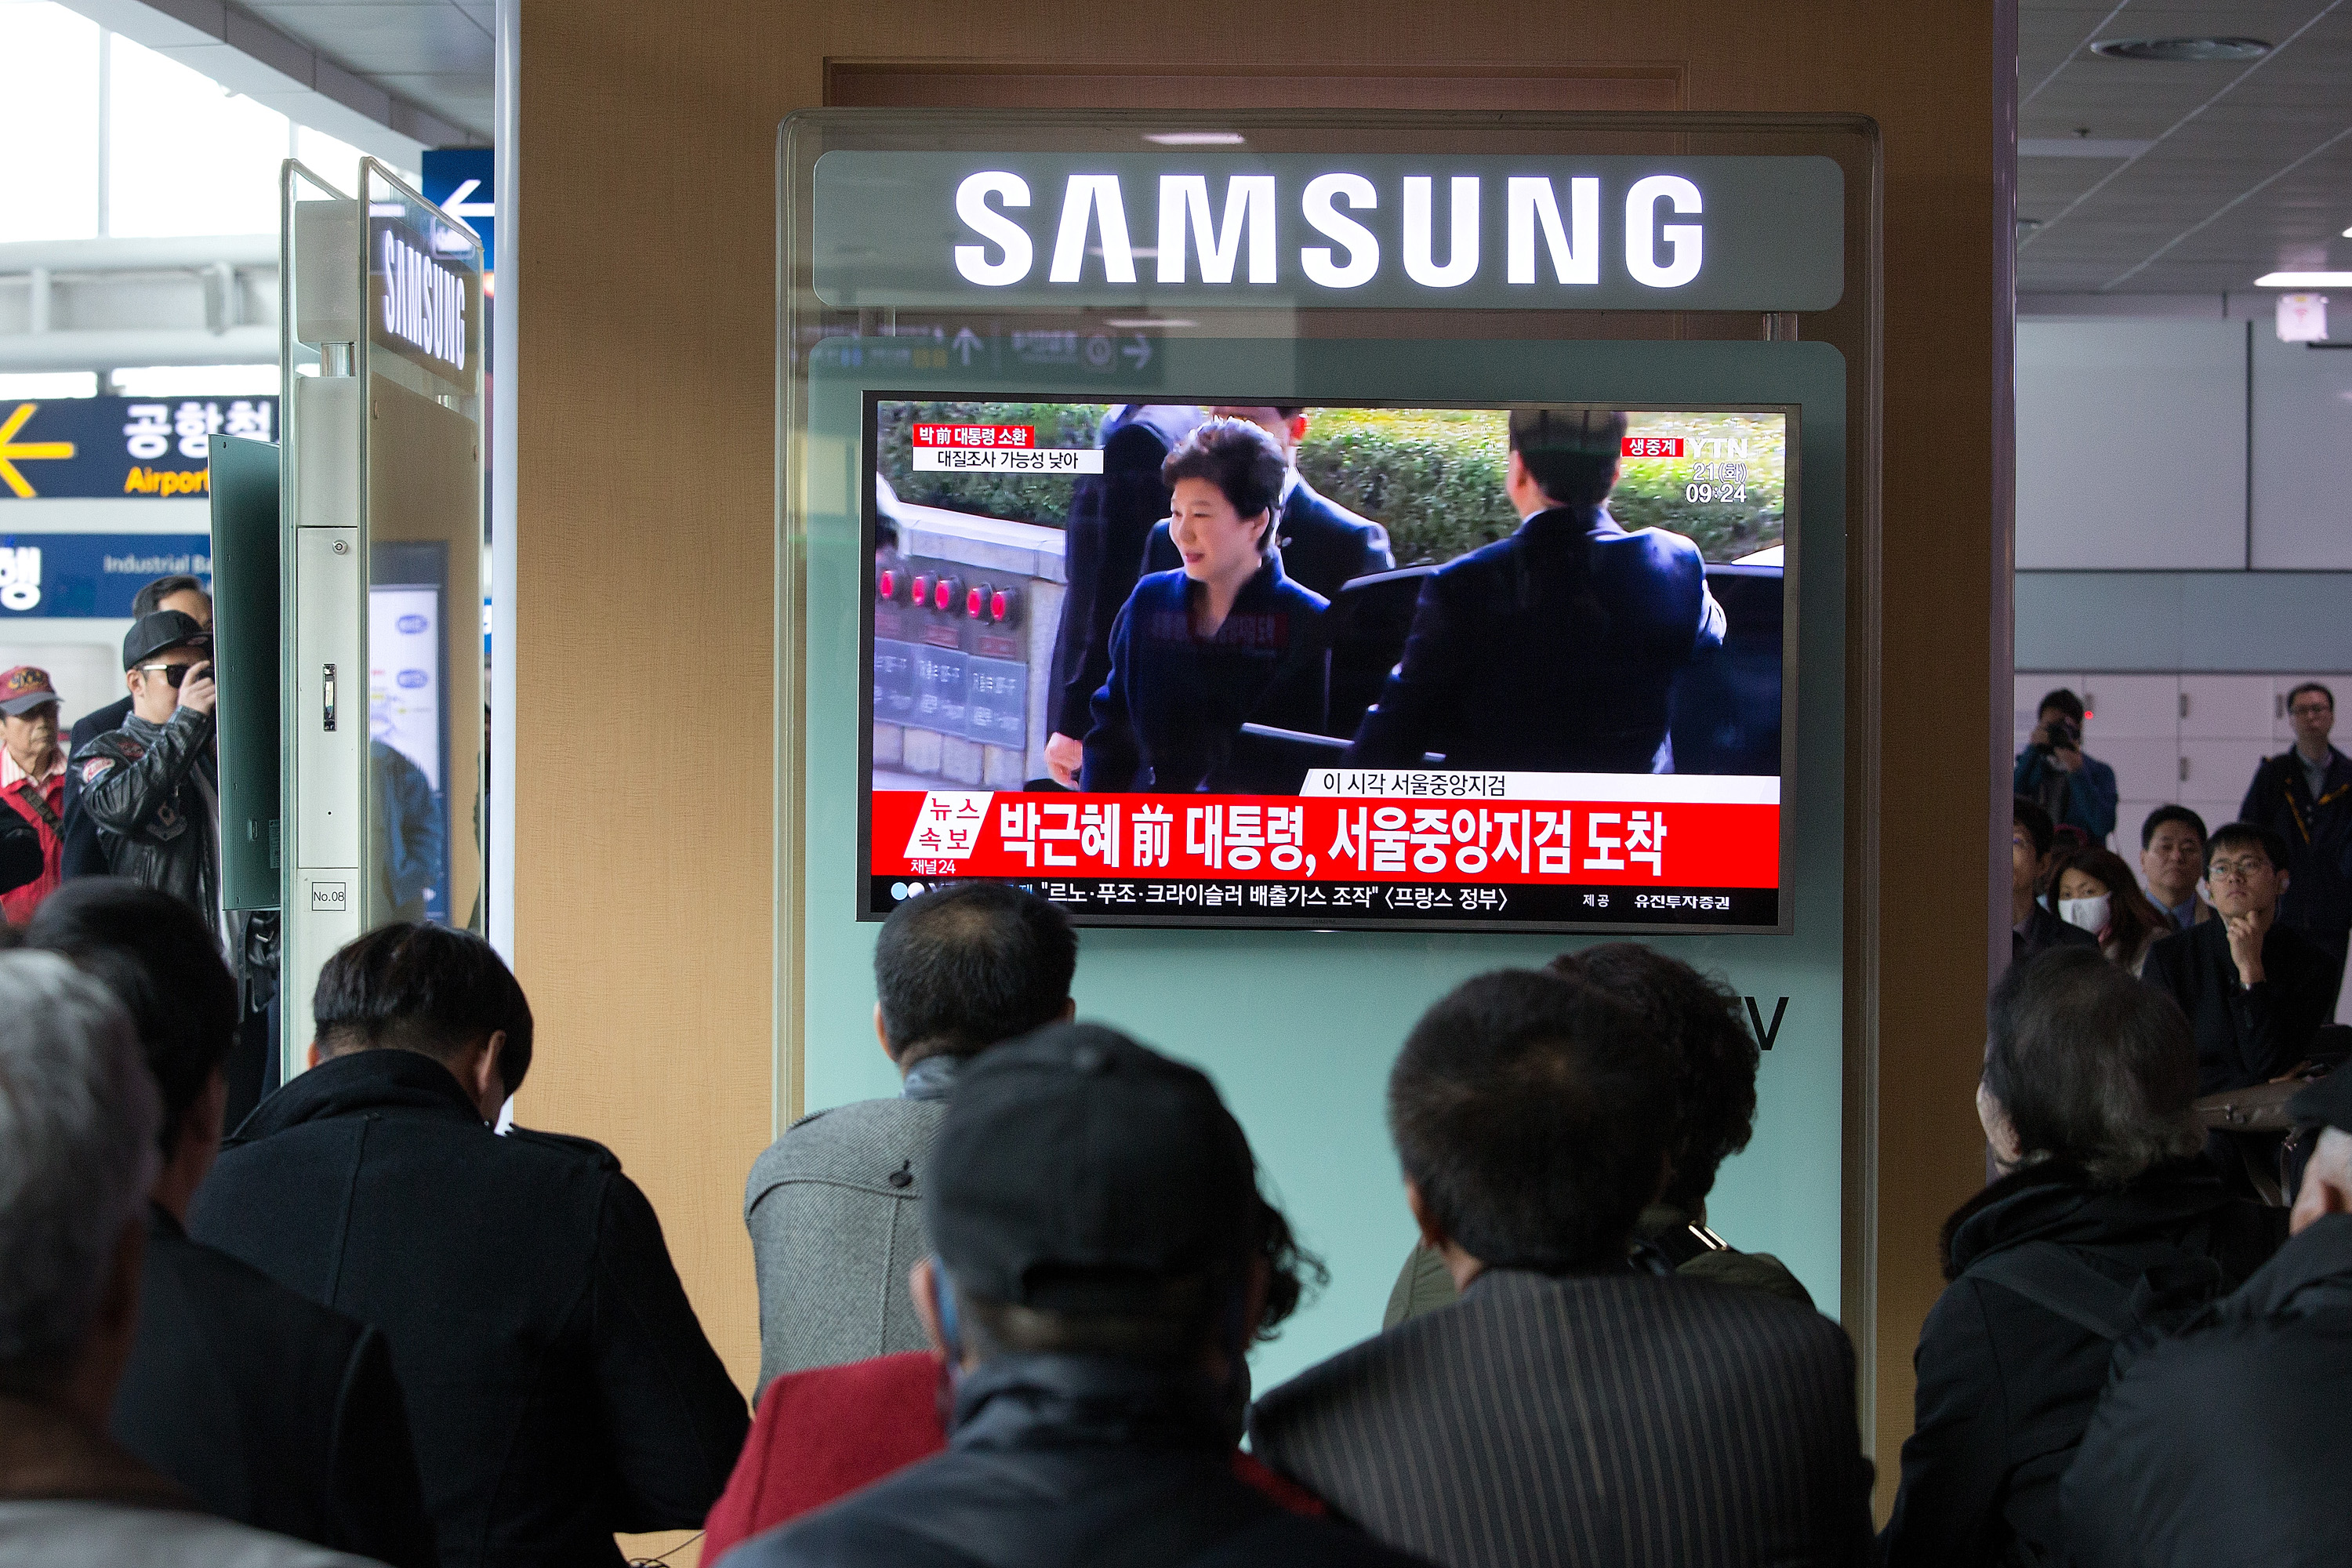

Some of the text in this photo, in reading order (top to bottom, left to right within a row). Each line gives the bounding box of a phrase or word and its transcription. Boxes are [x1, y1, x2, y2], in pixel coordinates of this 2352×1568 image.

[955, 171, 1703, 288] SAMSUNG
[383, 230, 465, 370] SAMSUNG
[122, 401, 279, 459] 공항철
[920, 427, 1028, 447] 박 前 대통령 소환
[1629, 439, 1677, 456] 생중계
[1686, 437, 1749, 459] YTN
[938, 451, 1079, 470] 대질조사 가능성 낮아
[1693, 462, 1748, 484] 21(화)
[1685, 482, 1748, 503] 09:24
[103, 554, 191, 575] Industrial
[1323, 772, 1505, 797] 이 시각 서울중앙지검
[930, 797, 980, 821] 뉴스
[918, 826, 971, 851] 속보
[1000, 802, 1668, 877] 박근혜 前 대통령, 서울중앙지검 도착
[910, 859, 956, 875] 채널24
[314, 891, 345, 902] No.08
[1250, 884, 1327, 907] 배출가스
[1331, 886, 1379, 909] 조작"
[1634, 894, 1730, 910] 유진투자증권
[1728, 996, 1790, 1051] V
